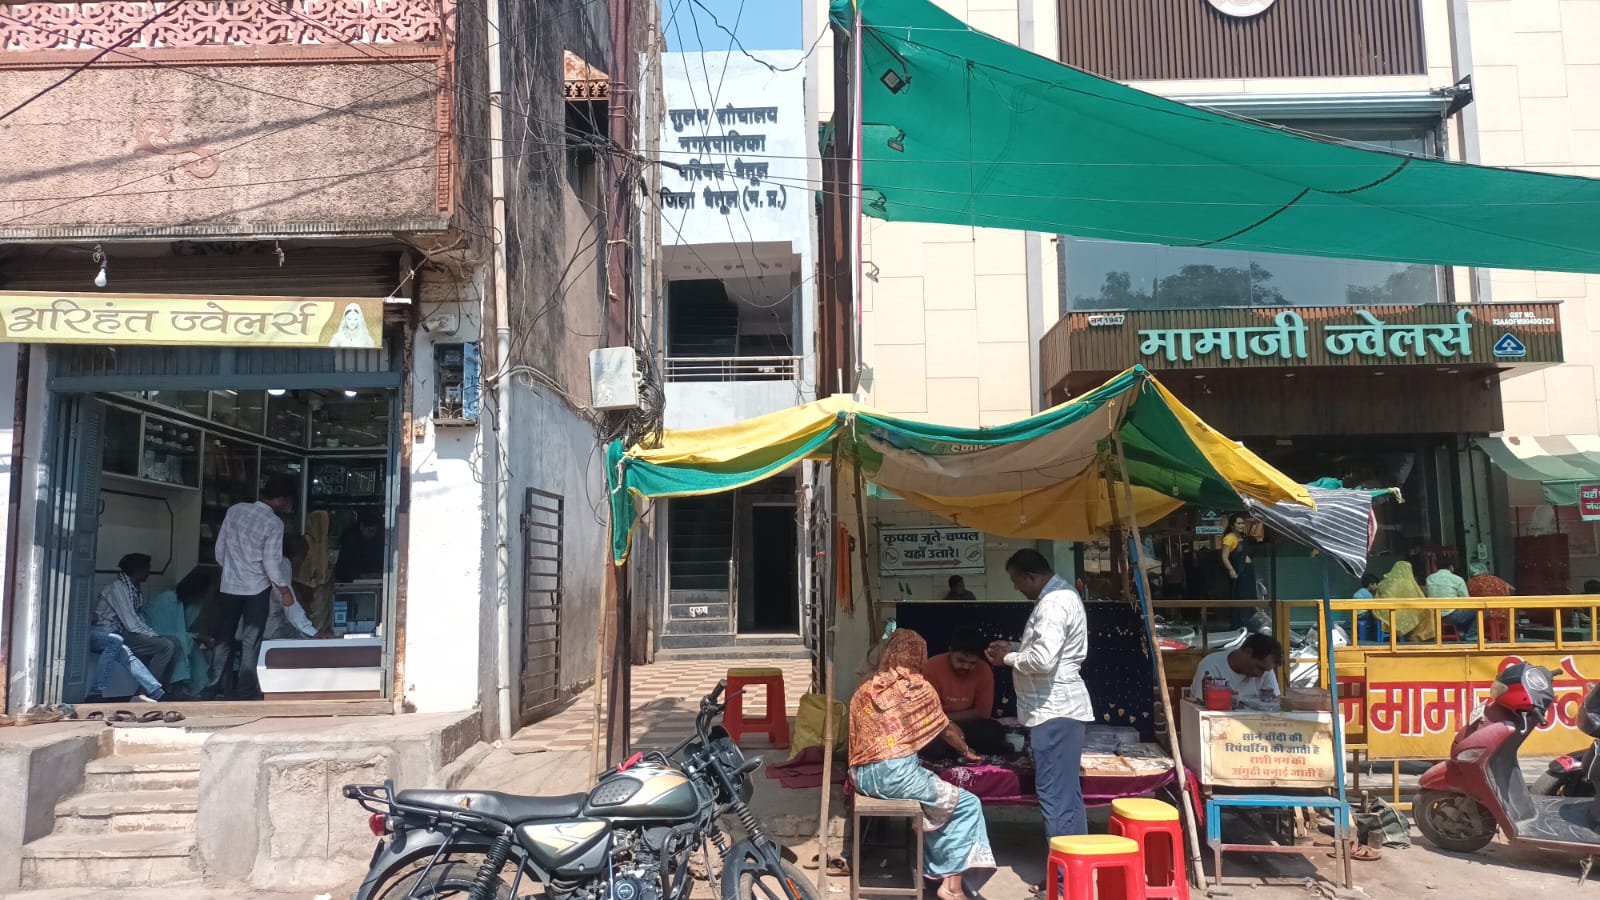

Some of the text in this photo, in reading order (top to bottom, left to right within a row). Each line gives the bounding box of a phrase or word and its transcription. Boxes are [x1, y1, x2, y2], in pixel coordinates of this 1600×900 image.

[717, 103, 778, 125] शौचालय
[678, 130, 766, 152] नगरपालिका
[659, 186, 695, 209] जिला
[8, 298, 319, 336] अरिहंत ज्वेलर्स
[1509, 311, 1523, 319] GST
[1138, 308, 1473, 361] मामाजी ज्वेलर्स
[882, 530, 979, 546] कृपया जूते-चप्पल
[903, 546, 927, 560] यहाँ
[689, 605, 709, 618] पुरुष
[1289, 731, 1304, 743] की
[1271, 743, 1284, 754] की
[1286, 744, 1311, 755] जाती
[1290, 767, 1316, 778] जाती
